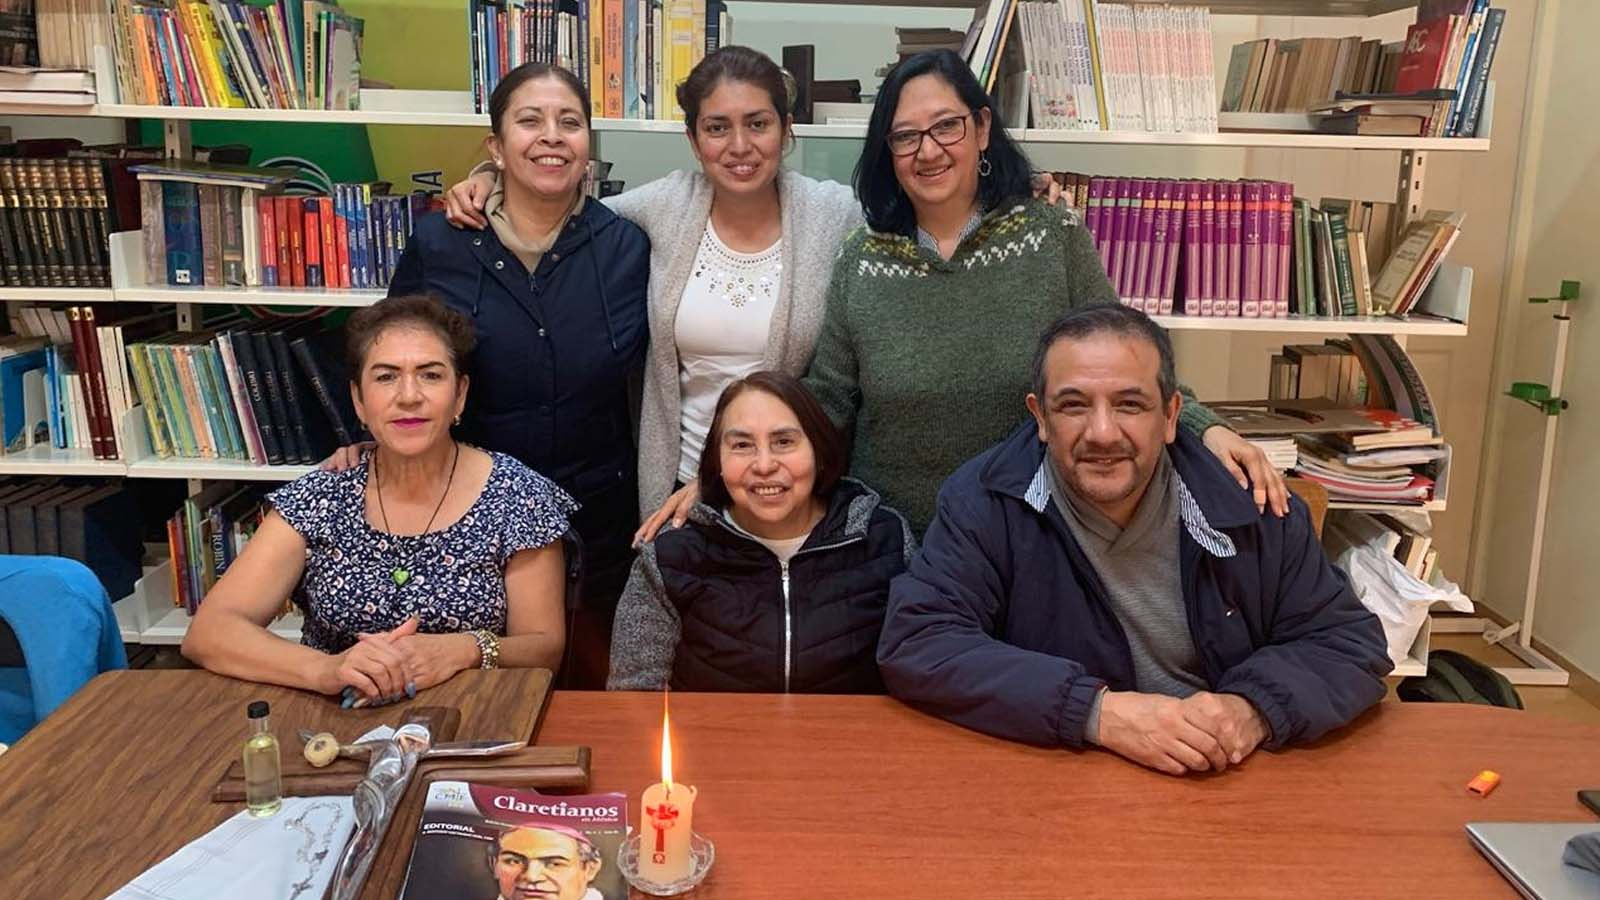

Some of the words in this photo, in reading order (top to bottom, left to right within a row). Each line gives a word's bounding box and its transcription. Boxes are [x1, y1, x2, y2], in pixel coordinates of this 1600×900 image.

[212, 533, 225, 570] ROBIN
[493, 795, 619, 817] Claretianos
[423, 823, 475, 833] EDITORIAL
